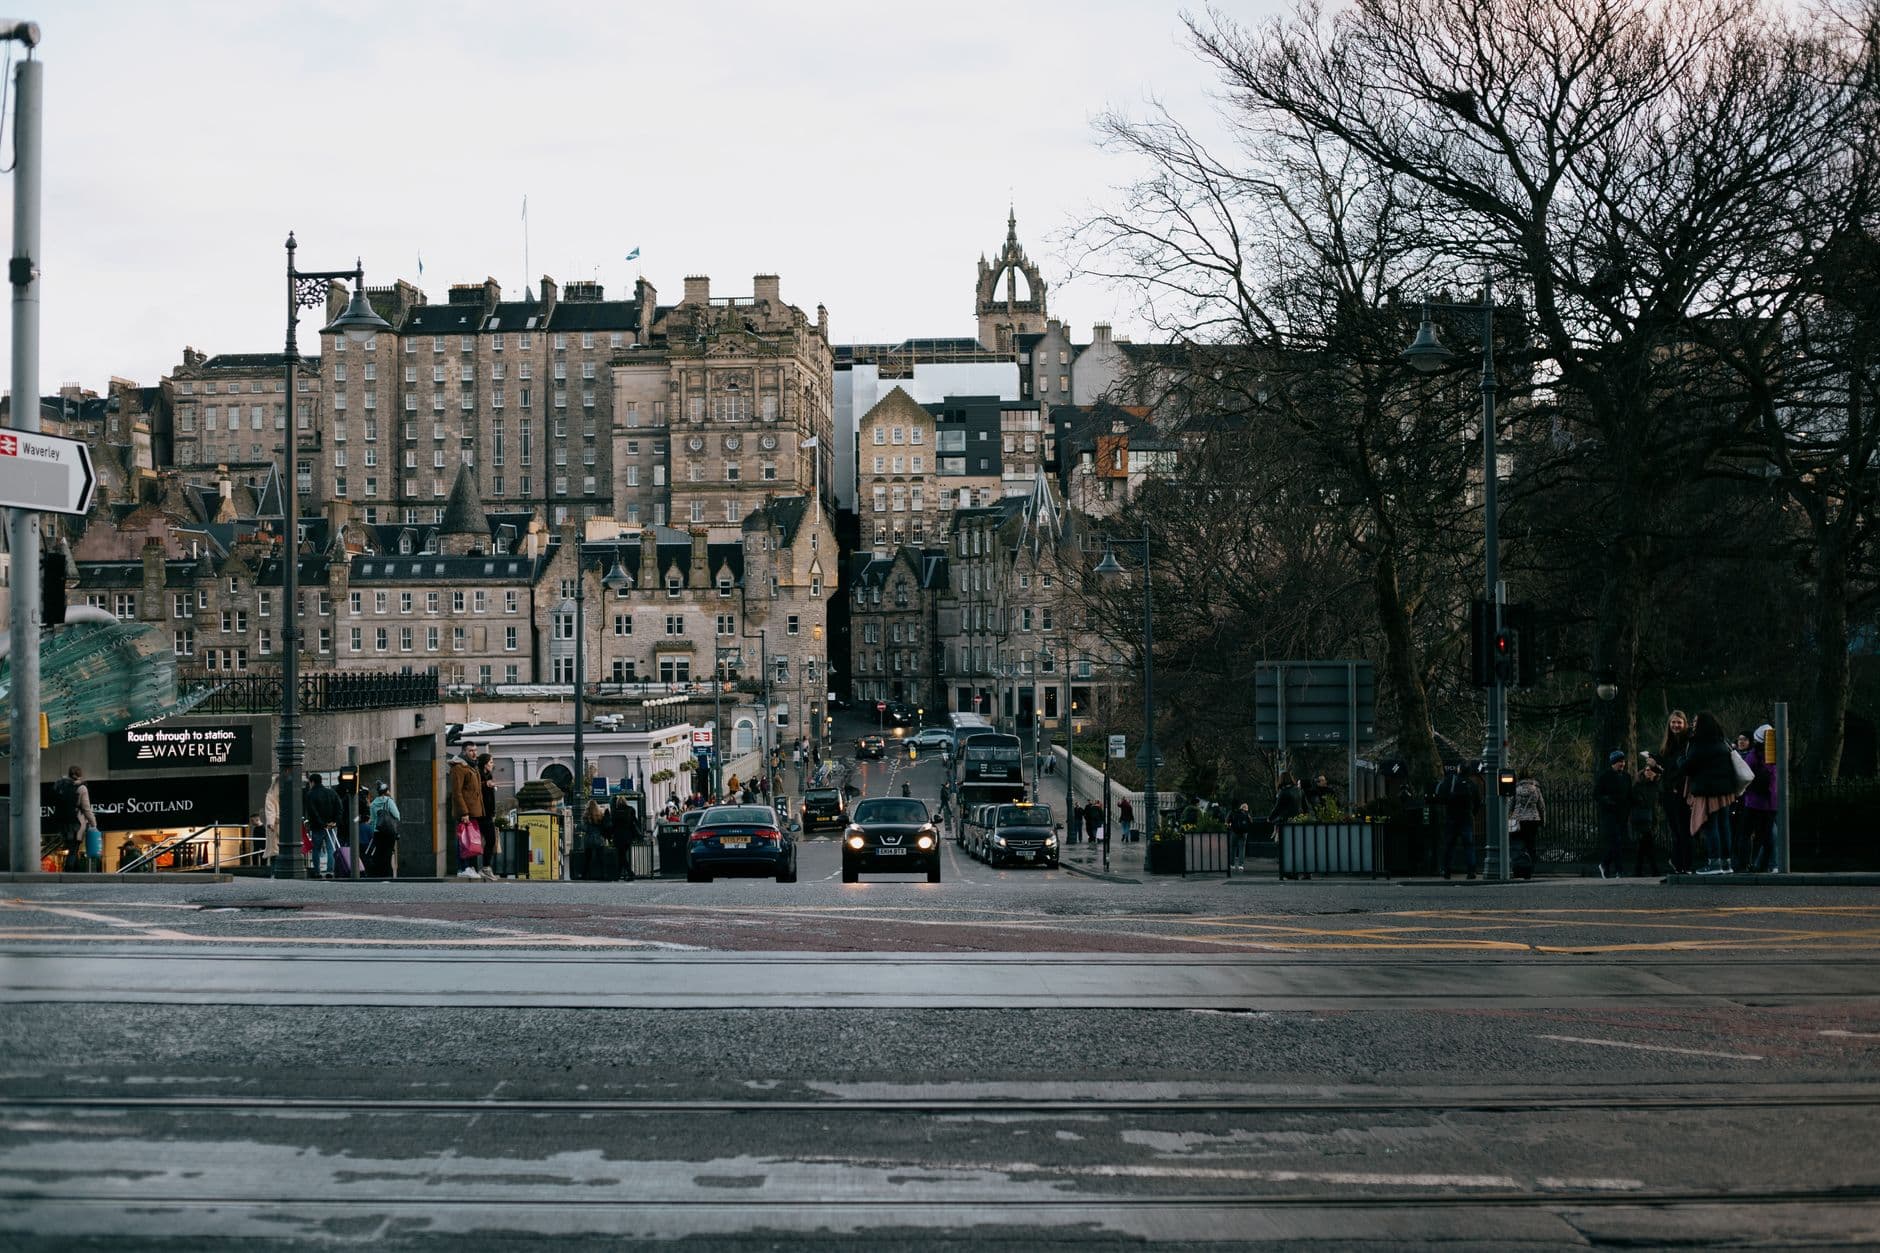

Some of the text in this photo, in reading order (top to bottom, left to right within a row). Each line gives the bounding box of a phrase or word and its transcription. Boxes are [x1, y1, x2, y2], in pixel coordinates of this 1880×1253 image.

[22, 441, 60, 461] Waverley
[127, 729, 236, 743] Route through to station.
[152, 743, 232, 757] WAVERLEY
[209, 752, 227, 763] mall
[108, 803, 124, 813] OF
